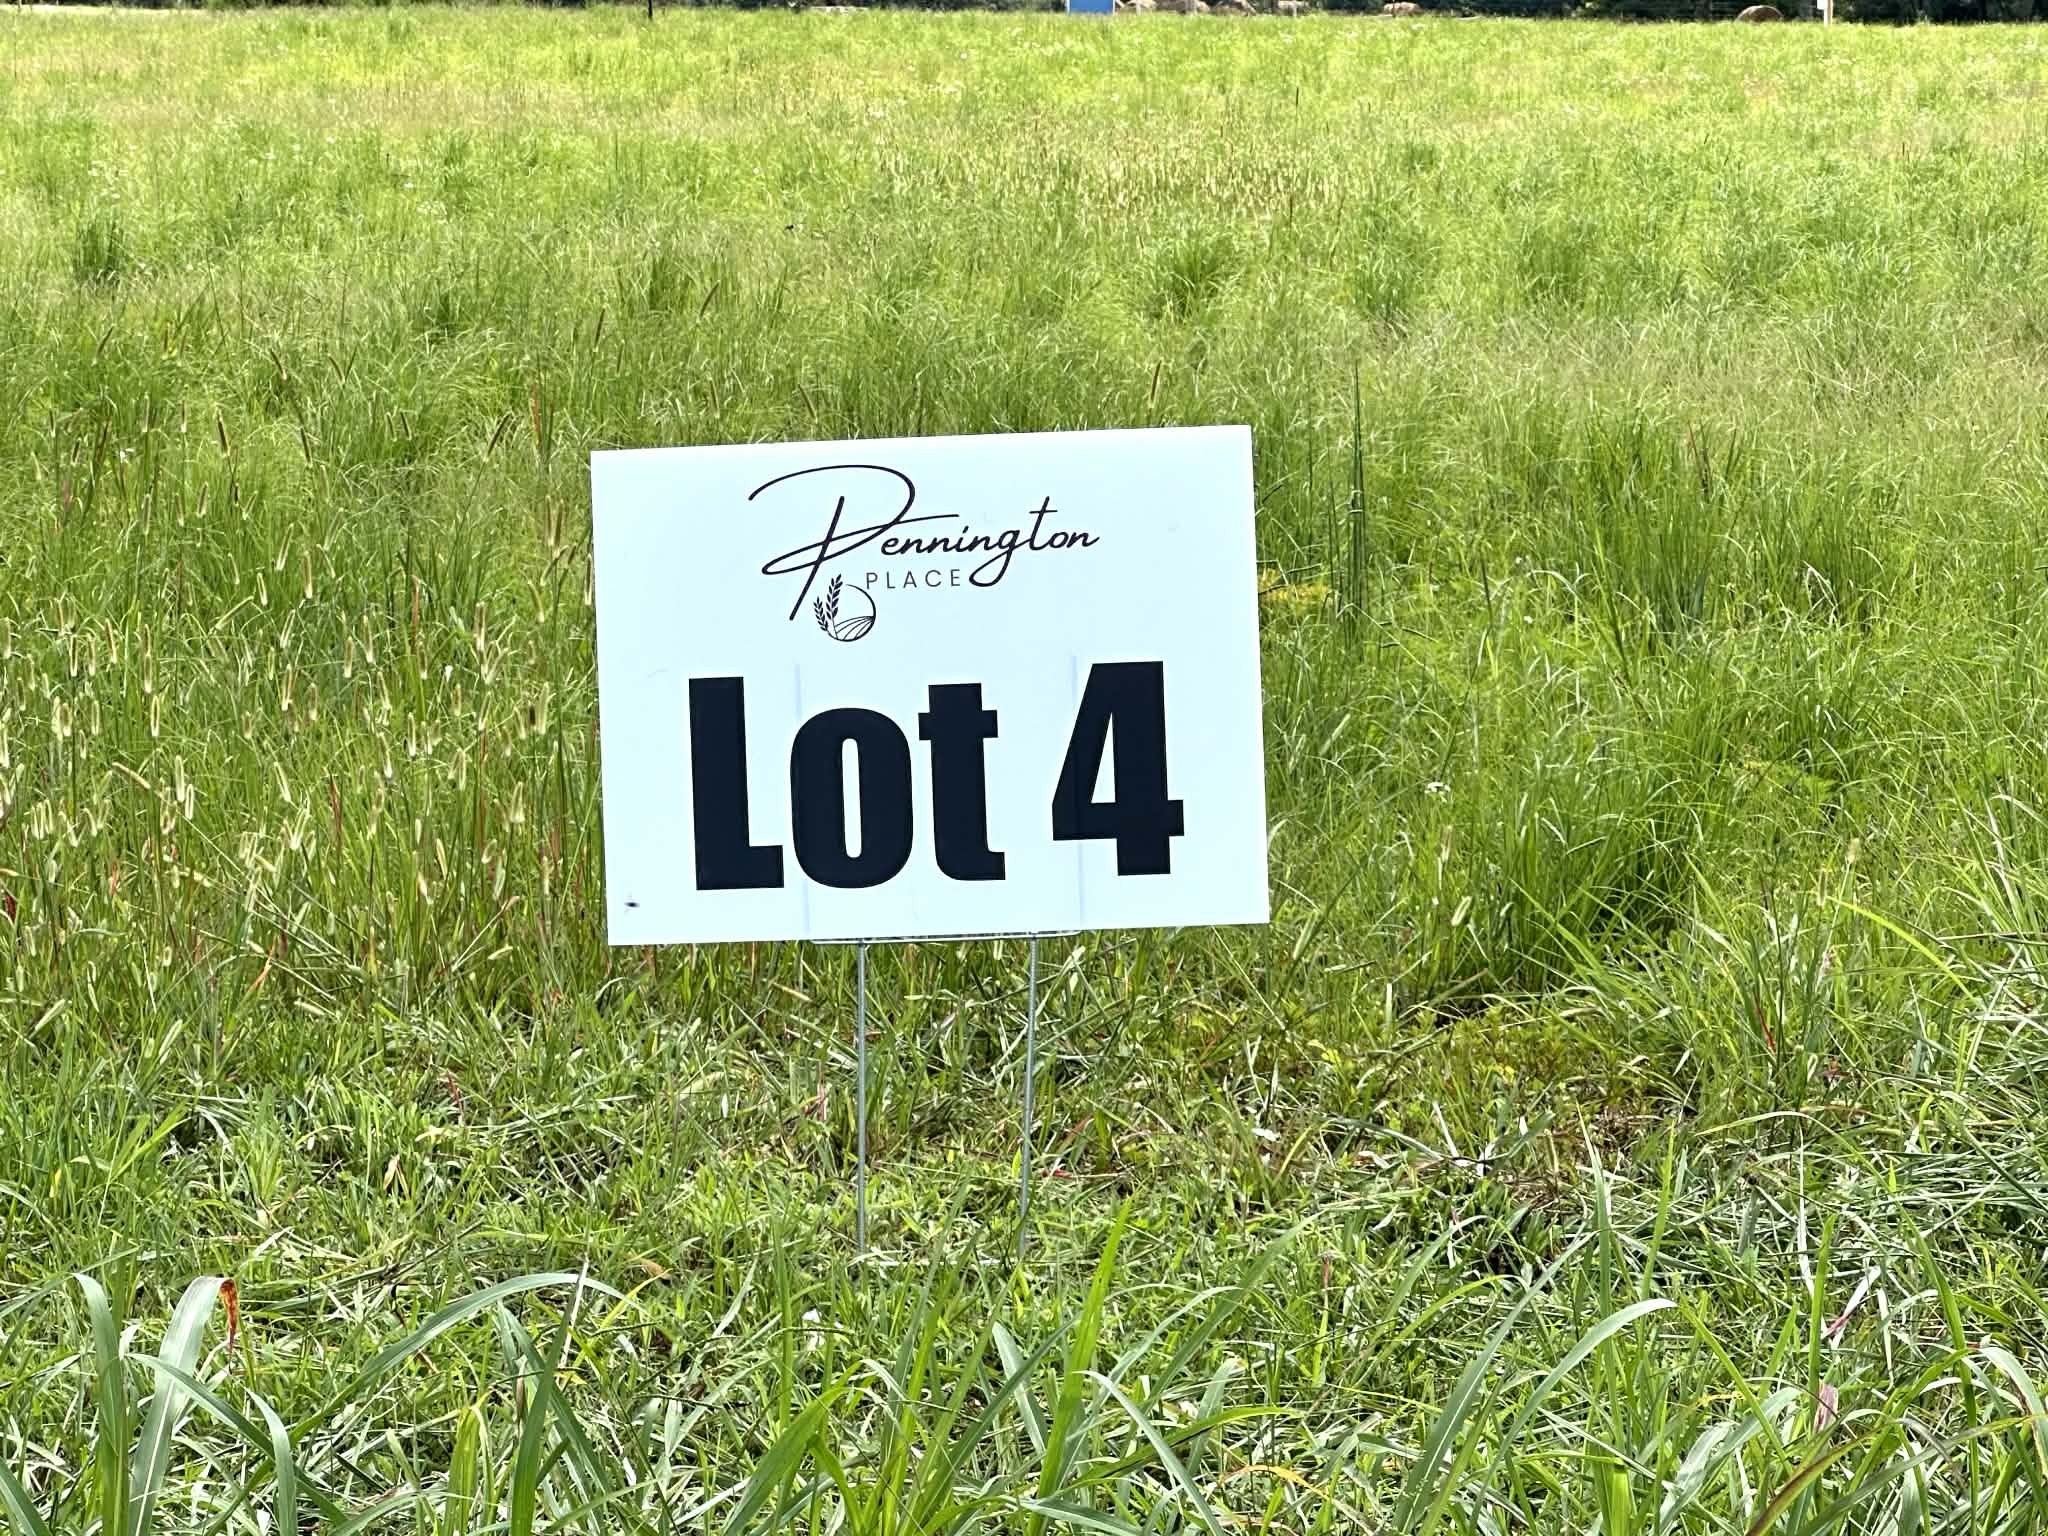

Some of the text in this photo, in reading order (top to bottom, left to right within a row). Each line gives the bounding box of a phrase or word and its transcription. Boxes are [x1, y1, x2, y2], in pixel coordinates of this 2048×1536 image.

[748, 464, 1100, 621] Pennington
[866, 569, 961, 590] PLACE
[688, 660, 1185, 891] Lot 4
